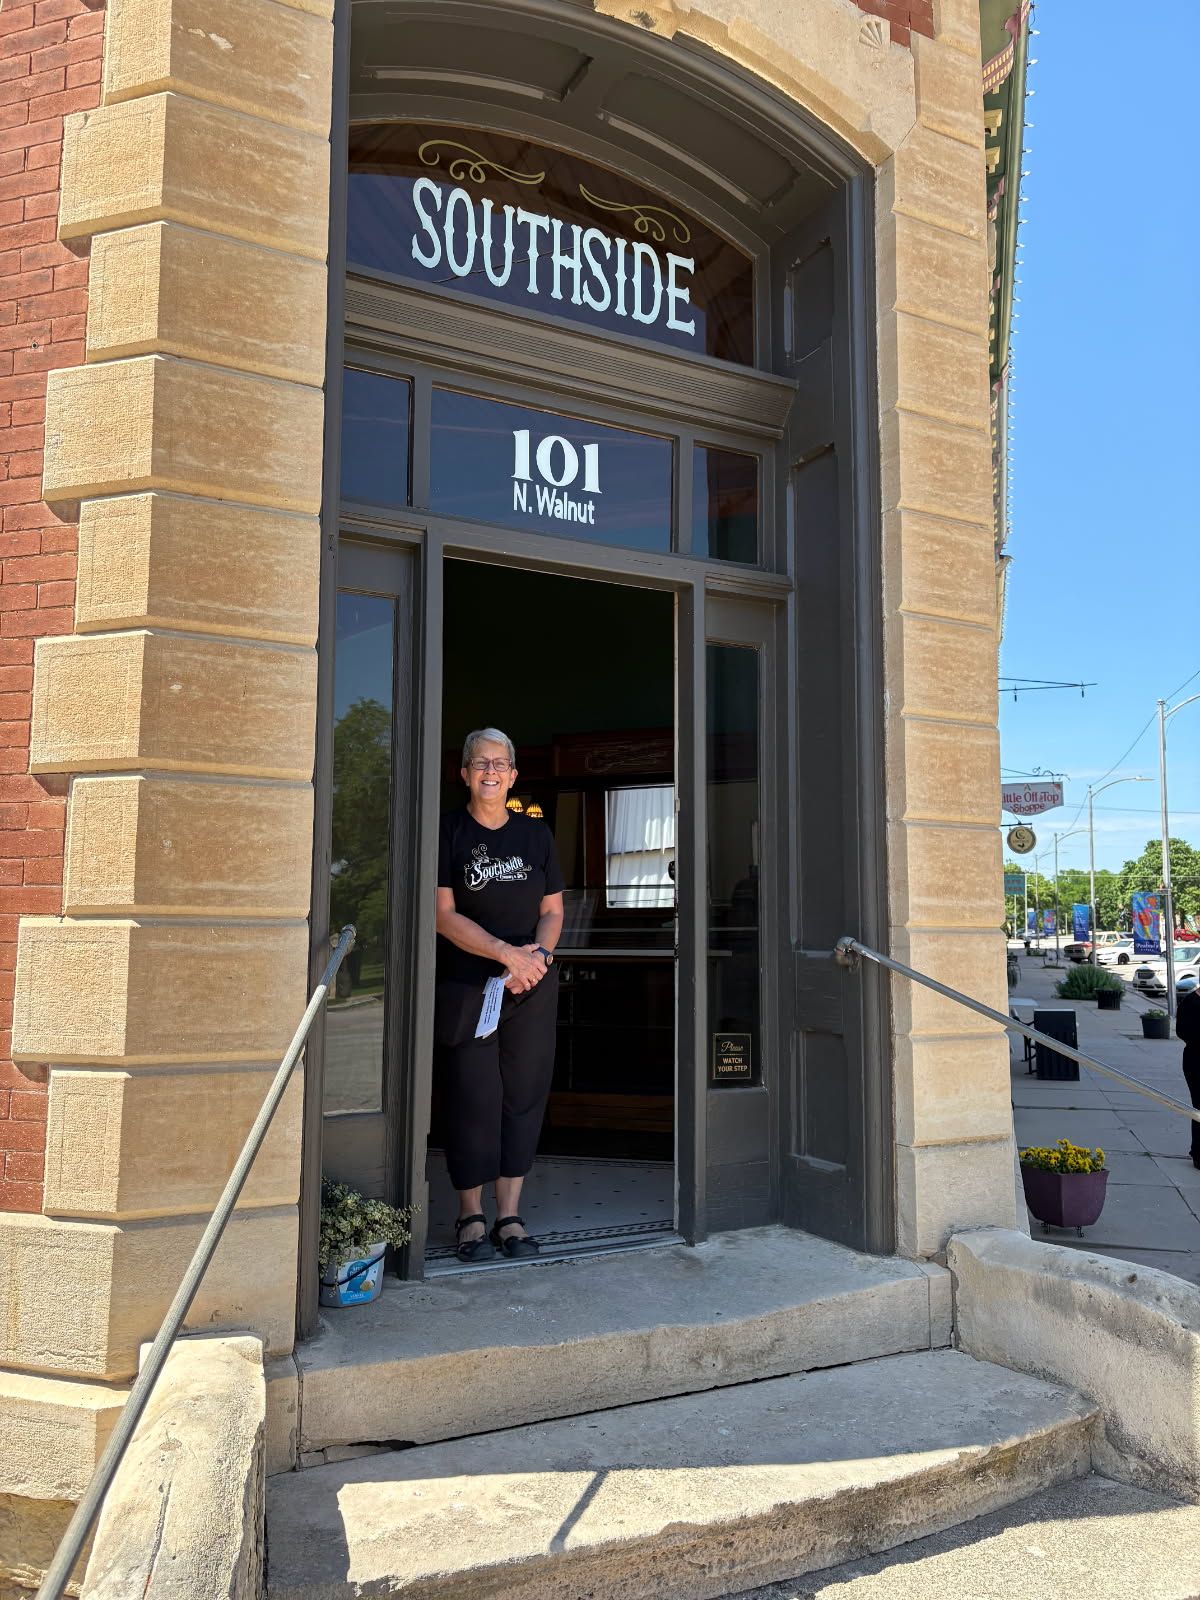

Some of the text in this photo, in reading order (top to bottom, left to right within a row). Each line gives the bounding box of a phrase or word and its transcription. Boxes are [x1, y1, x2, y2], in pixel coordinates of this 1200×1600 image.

[411, 177, 695, 336] SOUTHSIDE
[511, 429, 602, 494] 101
[513, 481, 595, 525] N. Walnut
[1002, 792, 1022, 803] ittle
[470, 856, 524, 887] Southside
